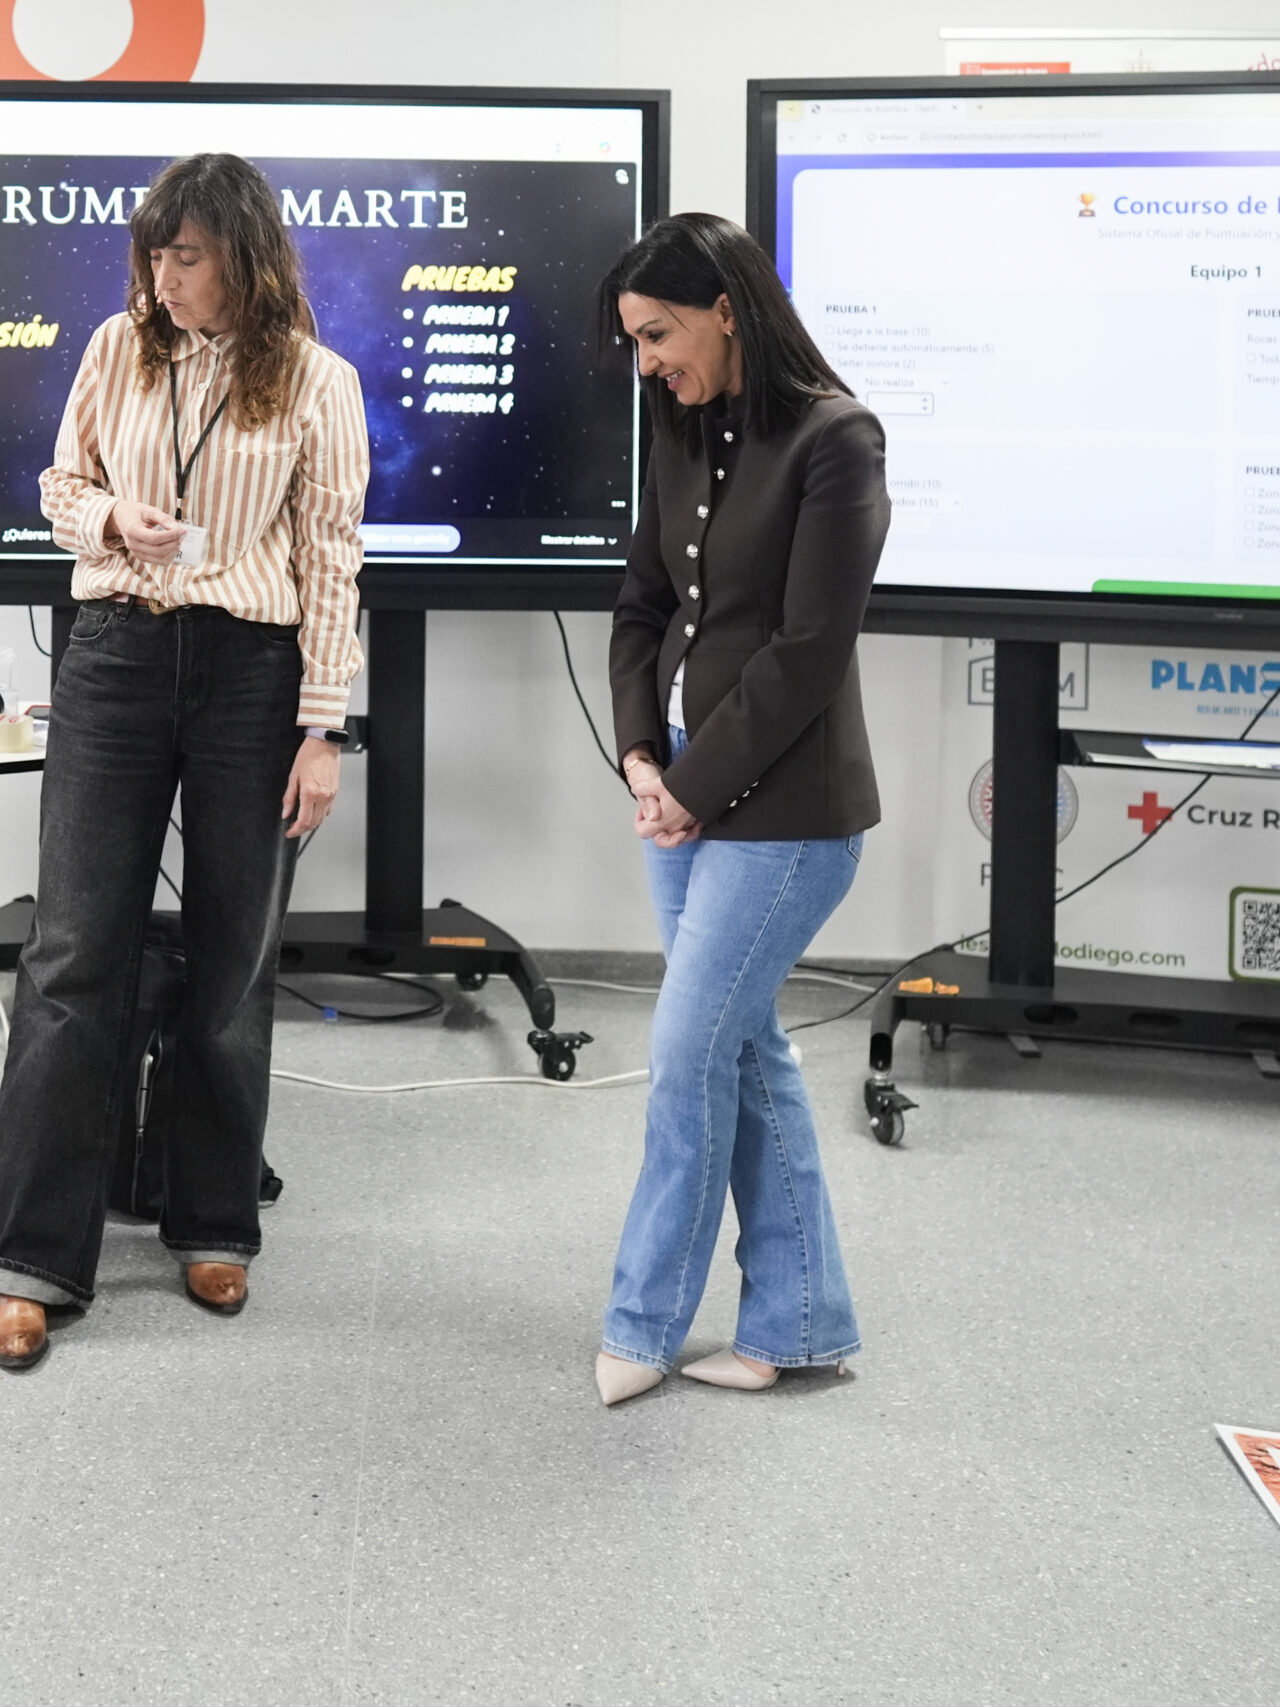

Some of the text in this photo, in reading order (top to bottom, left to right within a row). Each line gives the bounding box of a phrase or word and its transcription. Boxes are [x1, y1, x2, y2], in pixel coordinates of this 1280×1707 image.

[281, 189, 468, 228] MARTE
[1114, 195, 1229, 215] Concurso
[1238, 195, 1267, 215] de
[1097, 228, 1143, 239] Sistema
[1146, 228, 1183, 239] Oficial
[1186, 228, 1201, 239] de
[1205, 228, 1272, 240] Puntuación
[401, 264, 518, 292] PRUEBAS
[1190, 265, 1262, 281] Equipo 1
[422, 305, 510, 327] PRUEBA 1
[826, 305, 877, 314] PRUEBA 1
[837, 327, 863, 337] Llega
[886, 328, 909, 336] base
[912, 328, 932, 338] (10)
[499, 333, 516, 355] 2
[837, 343, 849, 351] Se
[852, 343, 888, 352] detiene
[498, 364, 515, 385] 3
[882, 377, 914, 387] realiza
[498, 392, 514, 414] 4
[888, 479, 920, 489] orrido
[1187, 804, 1253, 828] Cruz
